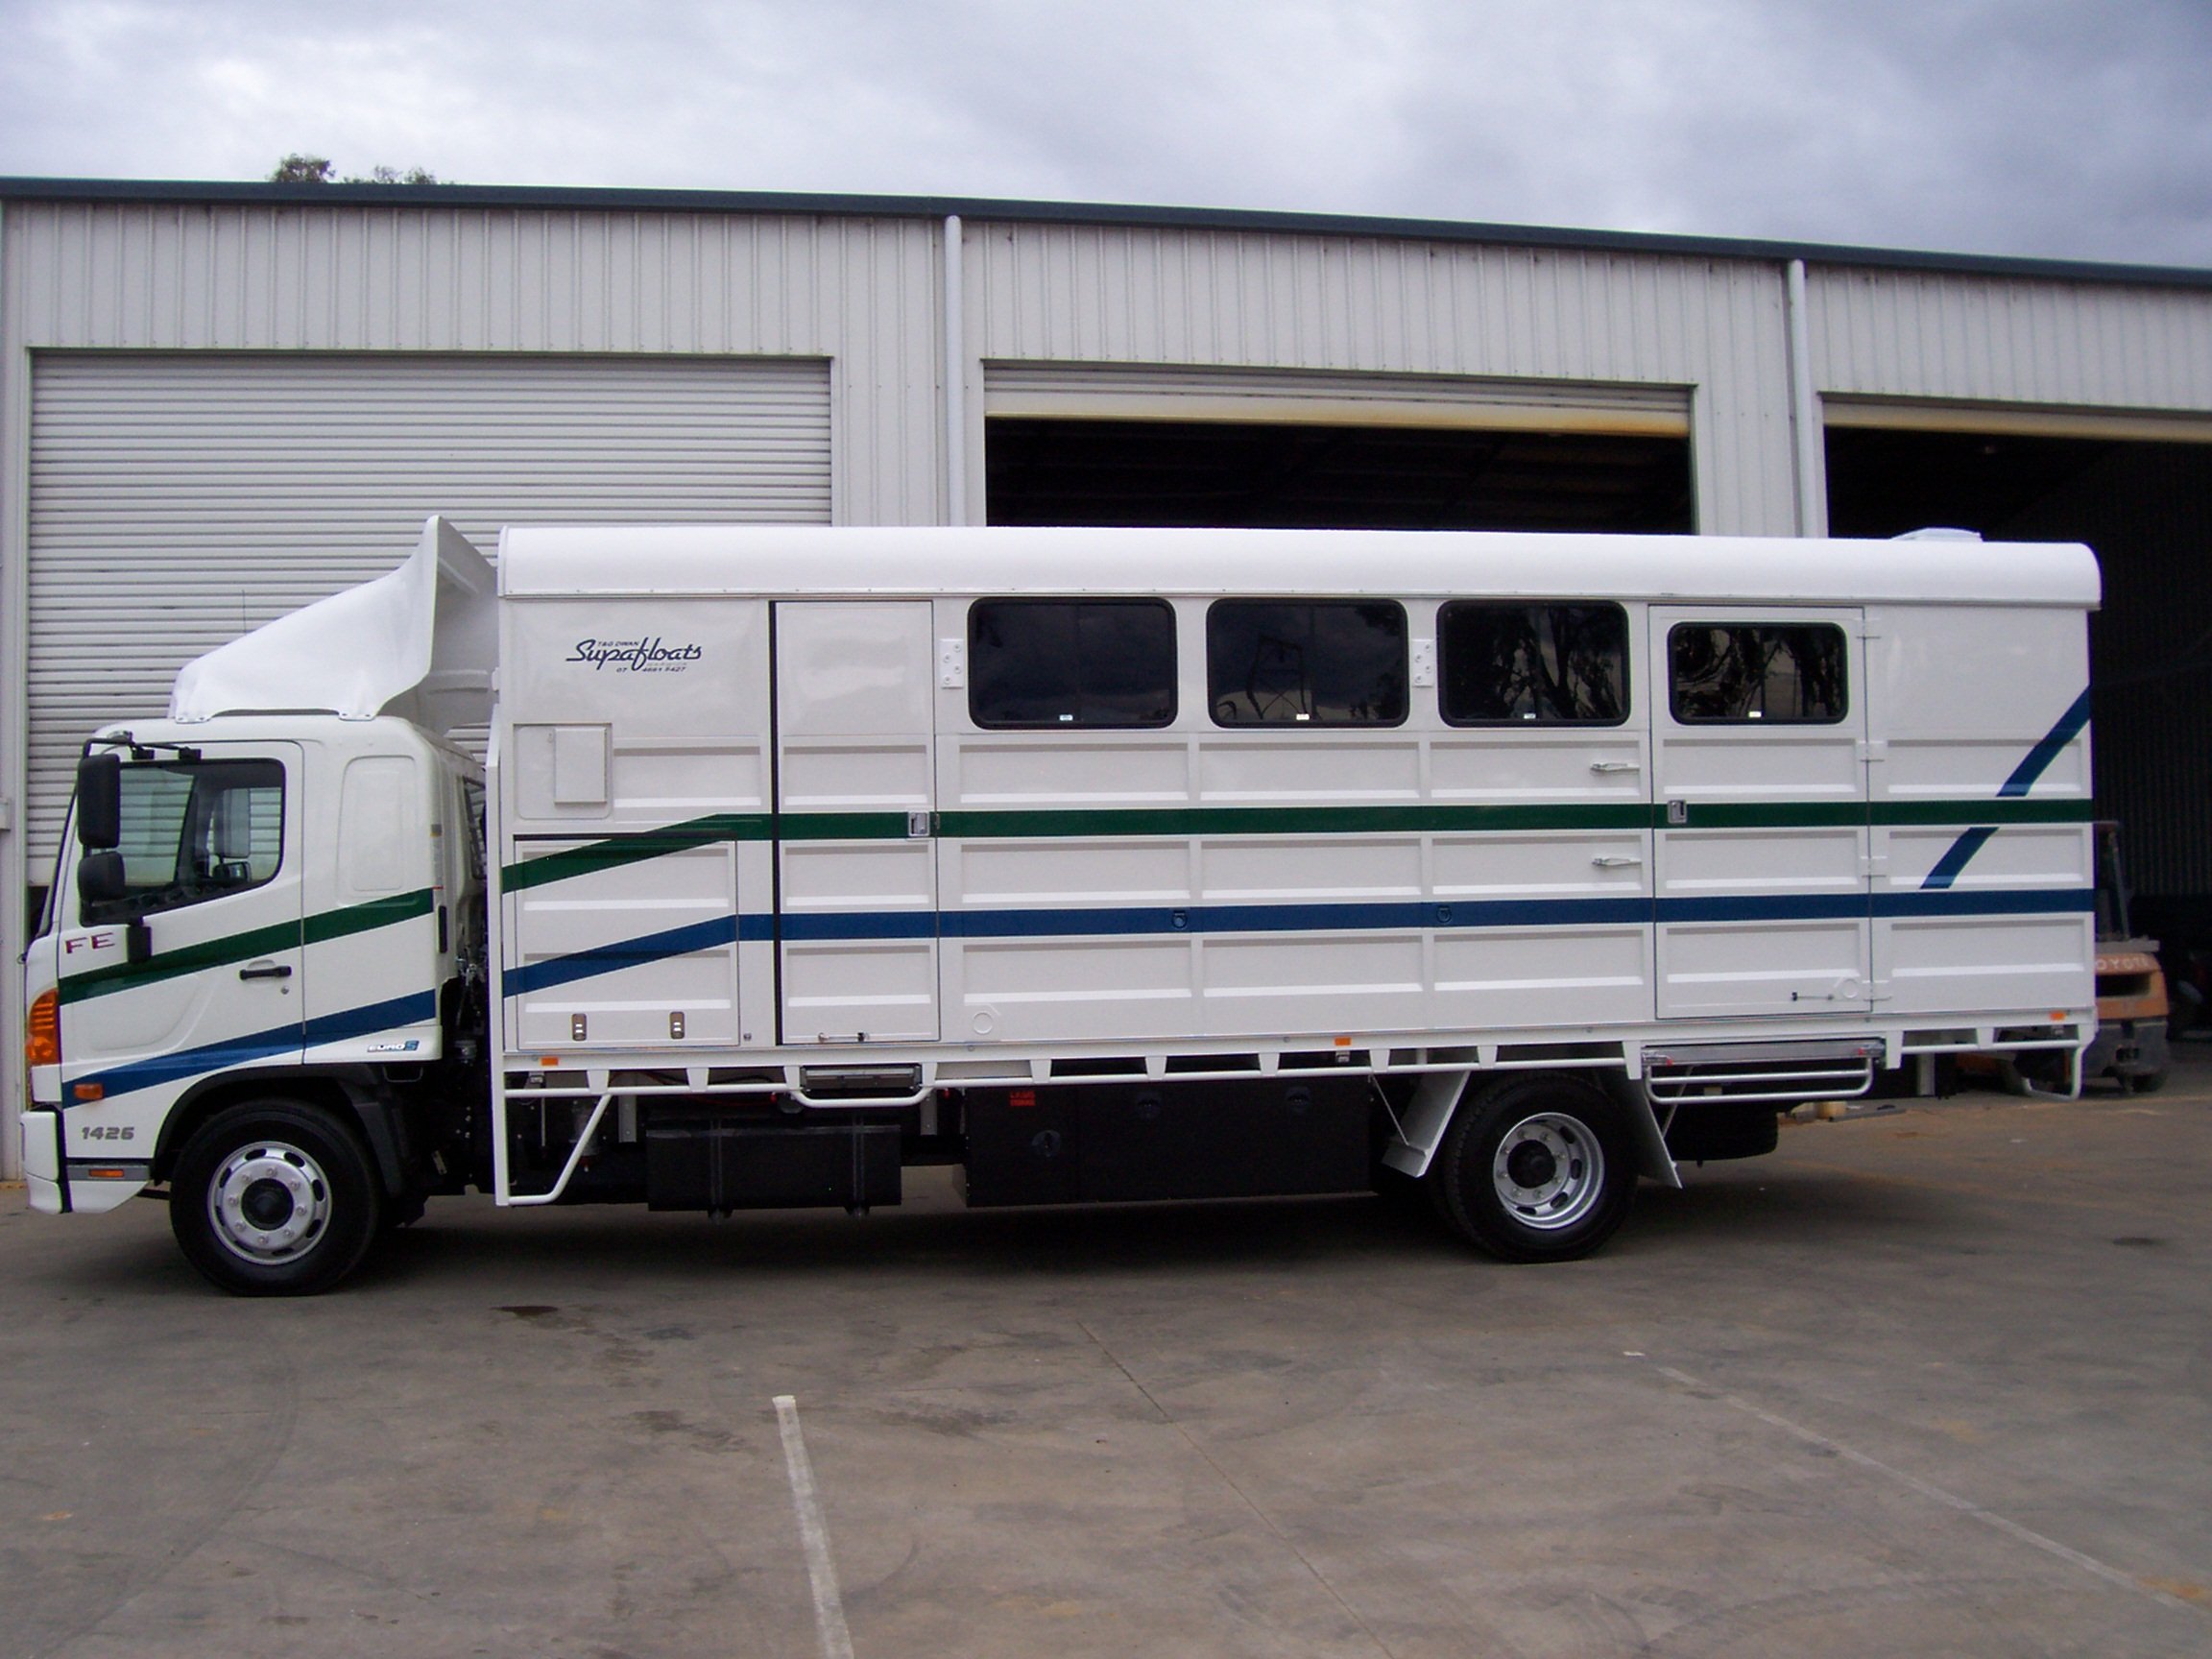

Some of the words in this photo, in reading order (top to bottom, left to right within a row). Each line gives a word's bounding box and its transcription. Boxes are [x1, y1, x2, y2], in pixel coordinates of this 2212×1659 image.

[565, 637, 702, 671] Supafloats
[65, 932, 115, 954] FE
[2096, 956, 2150, 971] OYOTA
[82, 1126, 134, 1141] 1426
